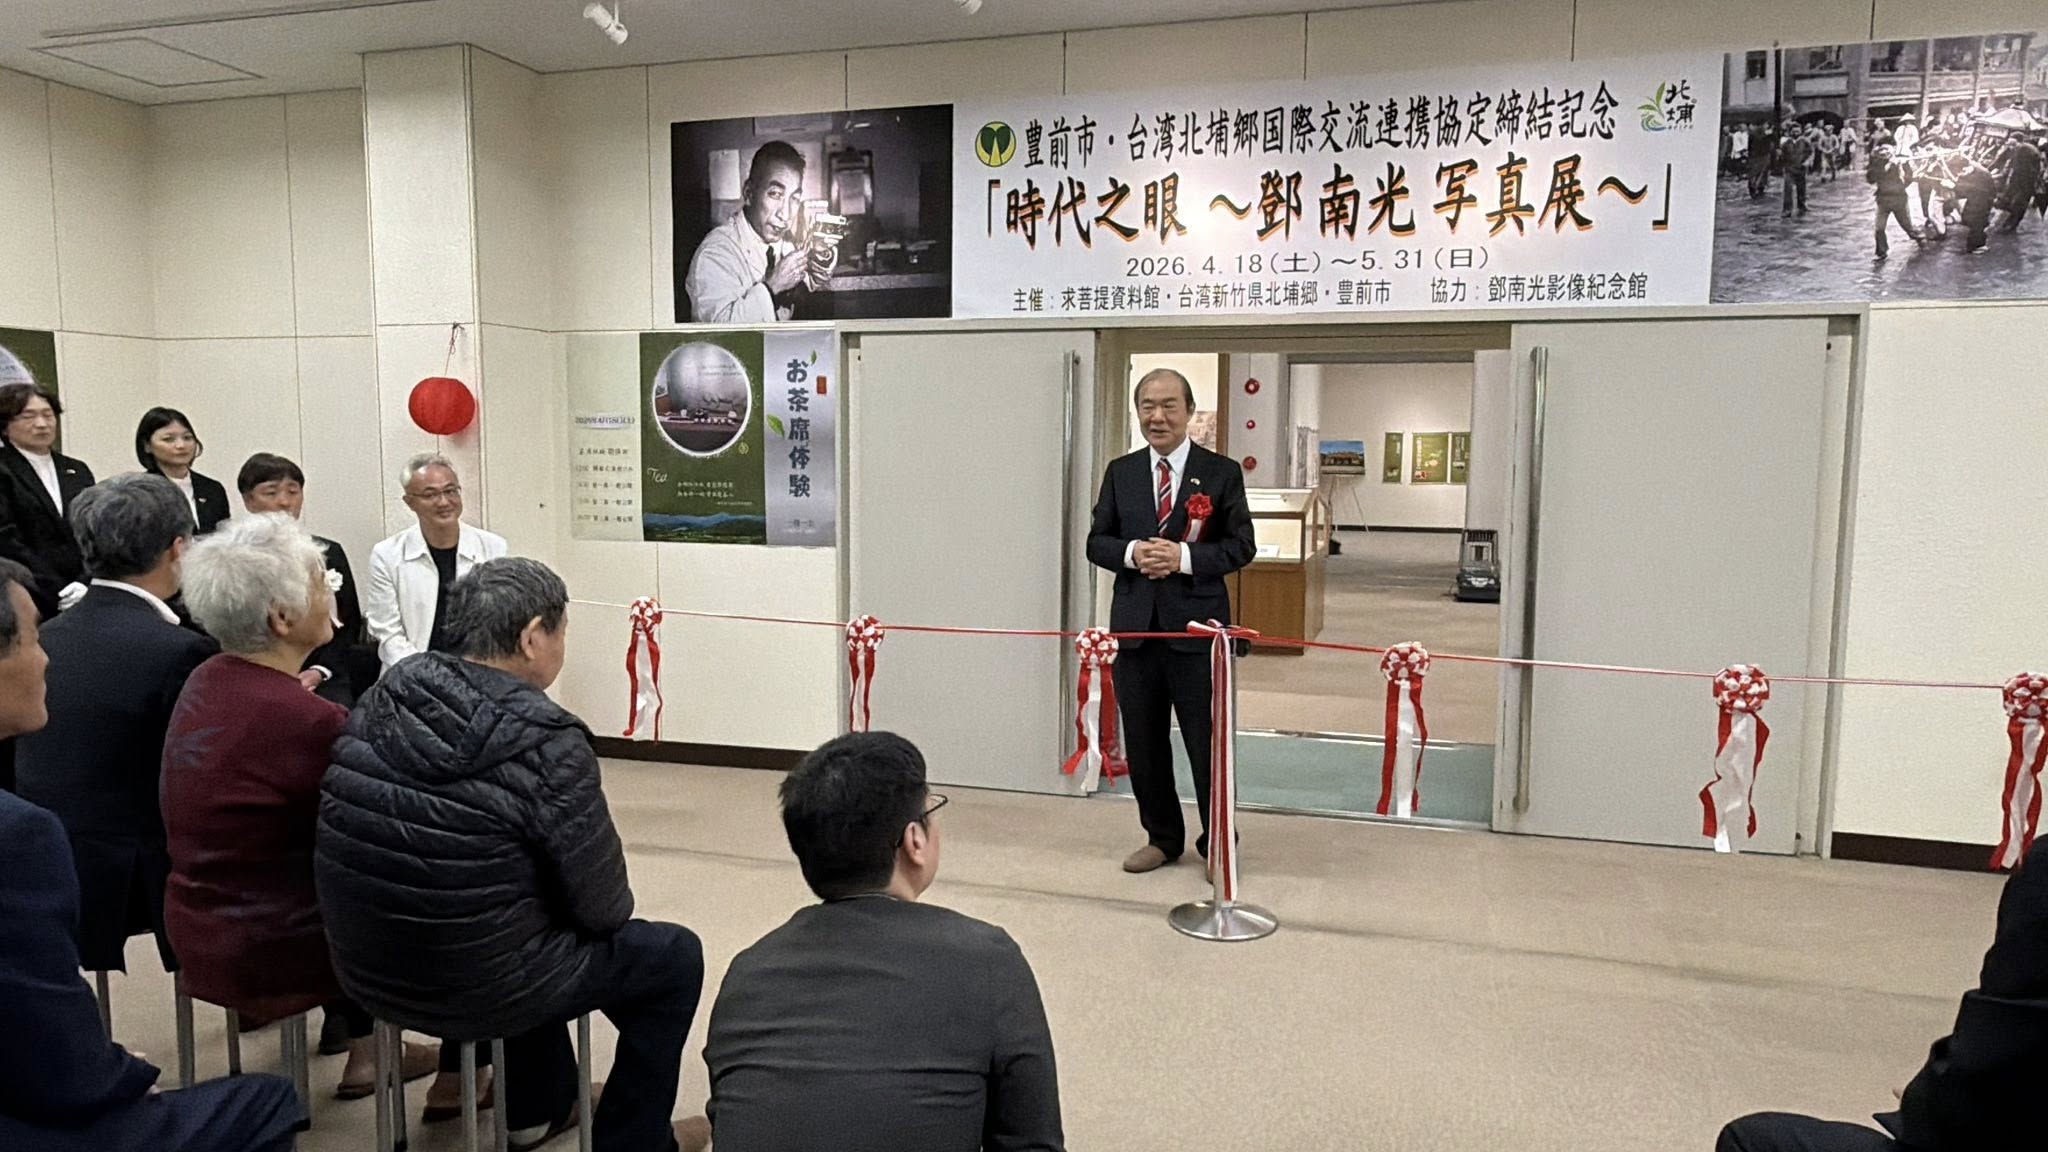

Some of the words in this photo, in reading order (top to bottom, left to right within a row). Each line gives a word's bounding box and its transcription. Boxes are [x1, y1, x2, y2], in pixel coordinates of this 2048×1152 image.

[787, 359, 810, 497] お茶席体験
[646, 467, 668, 483] Tea
